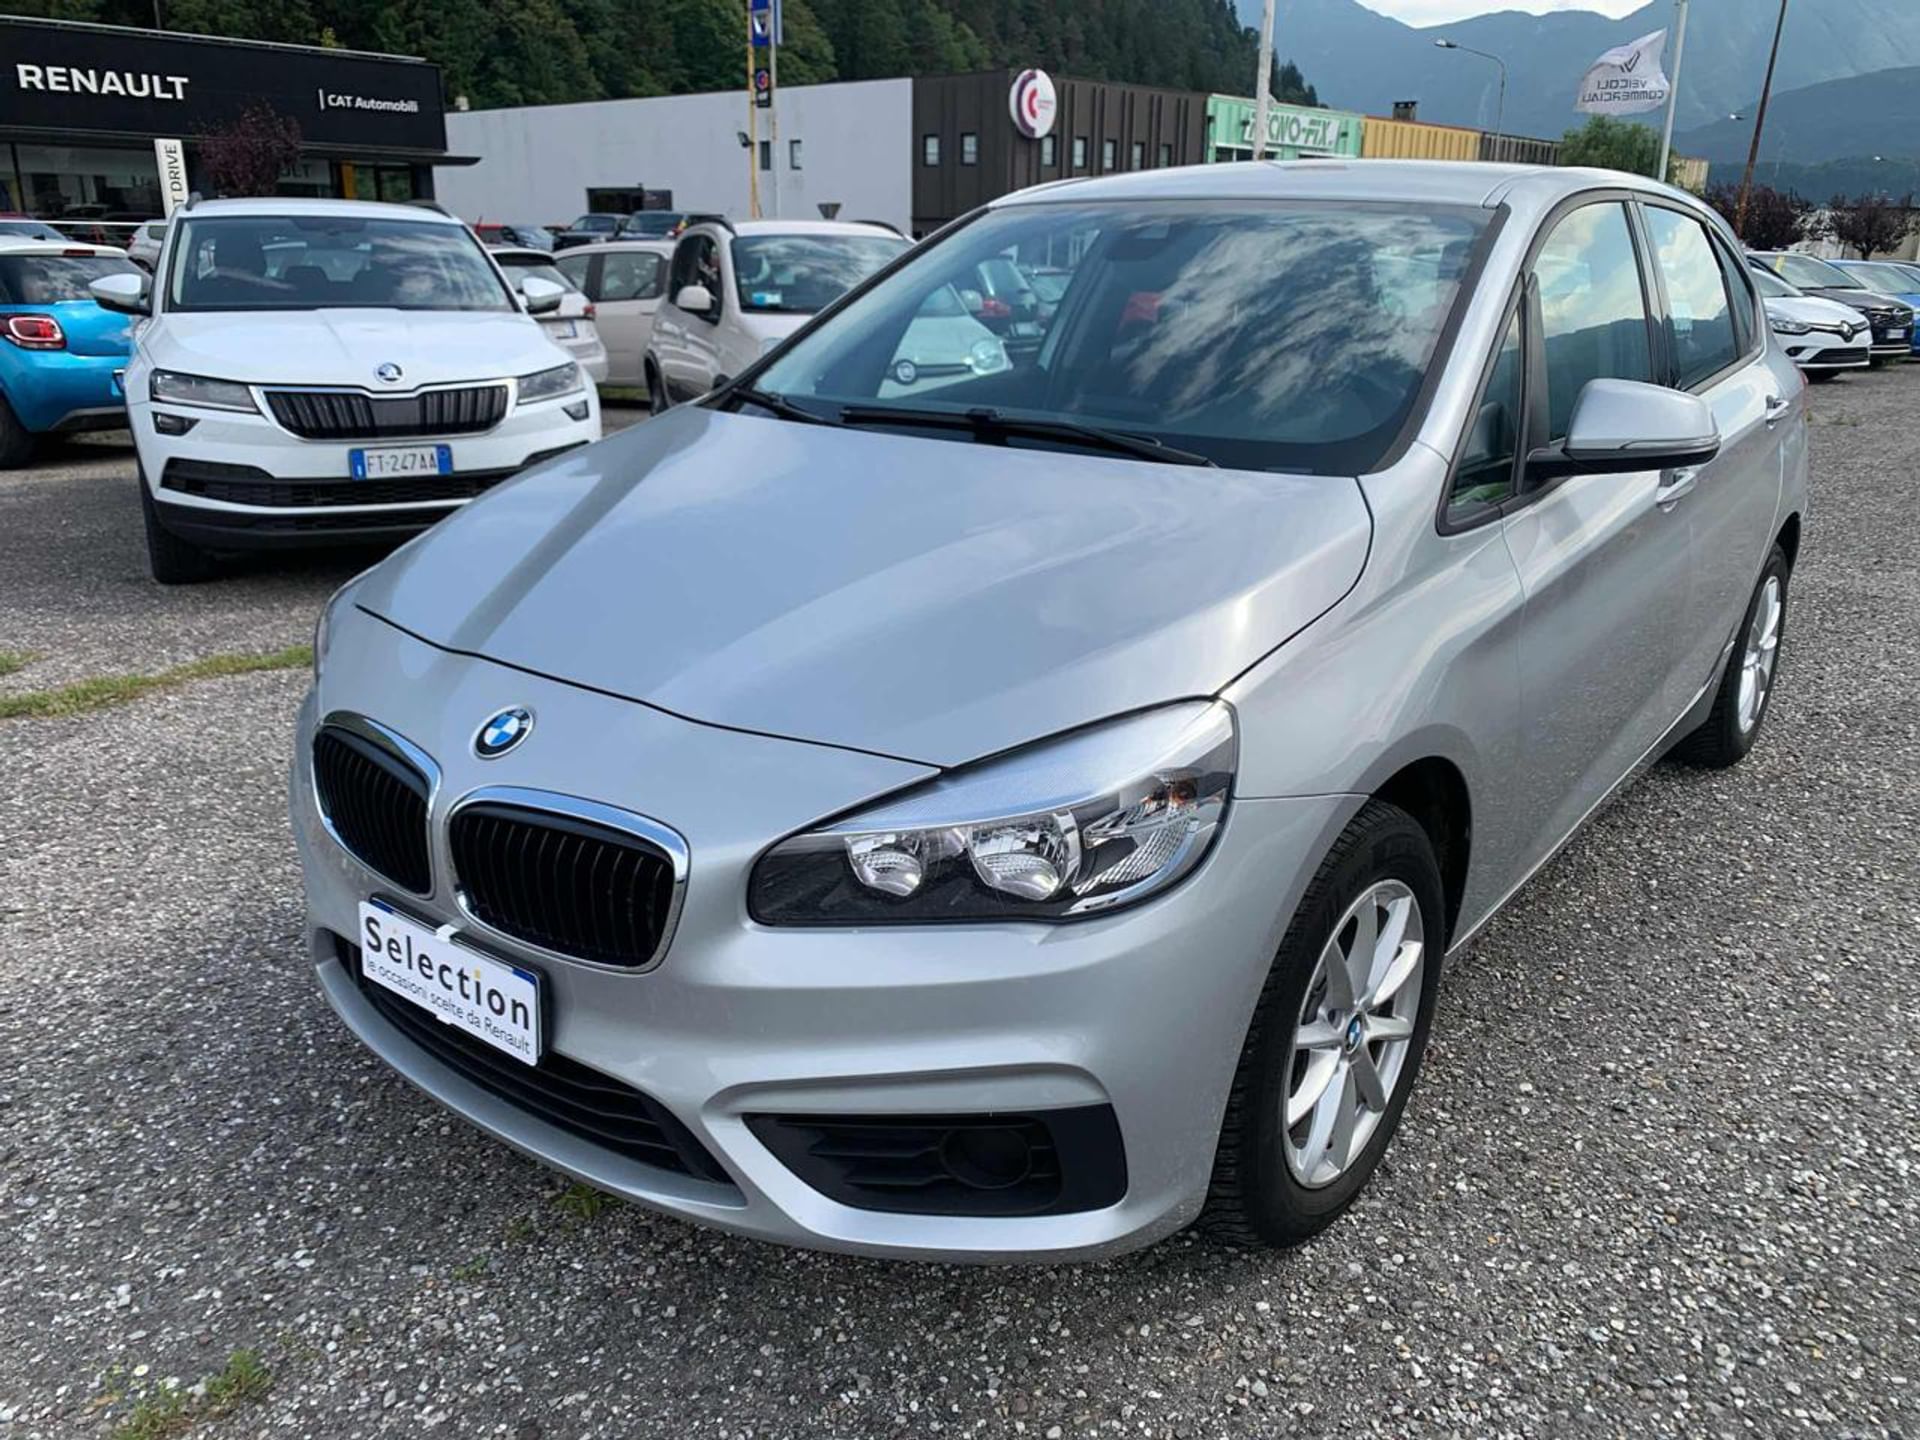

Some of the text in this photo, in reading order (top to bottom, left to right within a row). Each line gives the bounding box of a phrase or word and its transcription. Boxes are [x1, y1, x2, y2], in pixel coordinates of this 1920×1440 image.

[16, 63, 189, 100] RENAULT
[327, 94, 419, 113] CAT Automobili
[165, 144, 184, 193] DRIVE
[378, 964, 428, 1001] occasioni
[430, 991, 464, 1019] scelte
[466, 1009, 481, 1029] da
[484, 1016, 532, 1055] Renault
